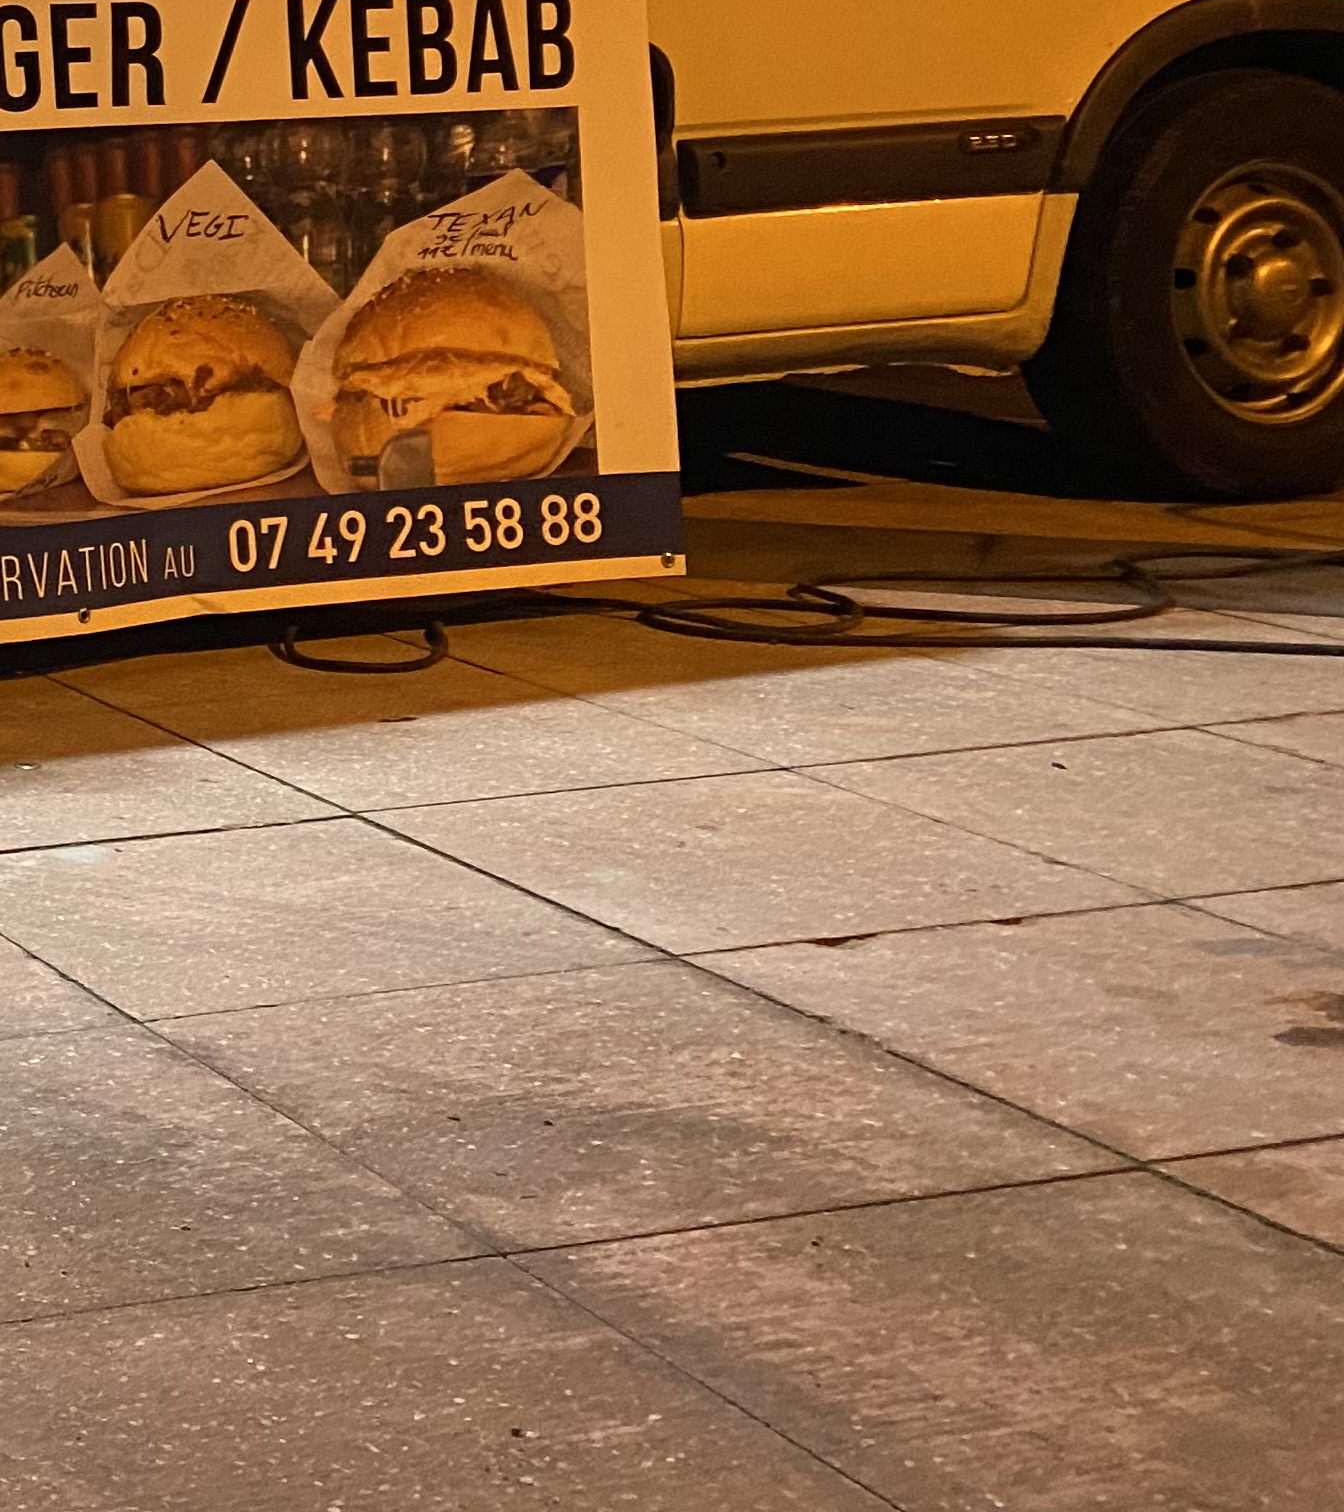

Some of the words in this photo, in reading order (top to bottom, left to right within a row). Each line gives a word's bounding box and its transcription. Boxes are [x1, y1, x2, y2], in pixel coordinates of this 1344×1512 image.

[156, 209, 250, 244] VEGI
[427, 199, 549, 234] TEXAN
[164, 544, 196, 580] AU
[229, 516, 289, 573] 07
[307, 510, 368, 565] 49
[386, 503, 447, 559] 23
[463, 497, 525, 552] 58
[540, 492, 604, 546] 88
